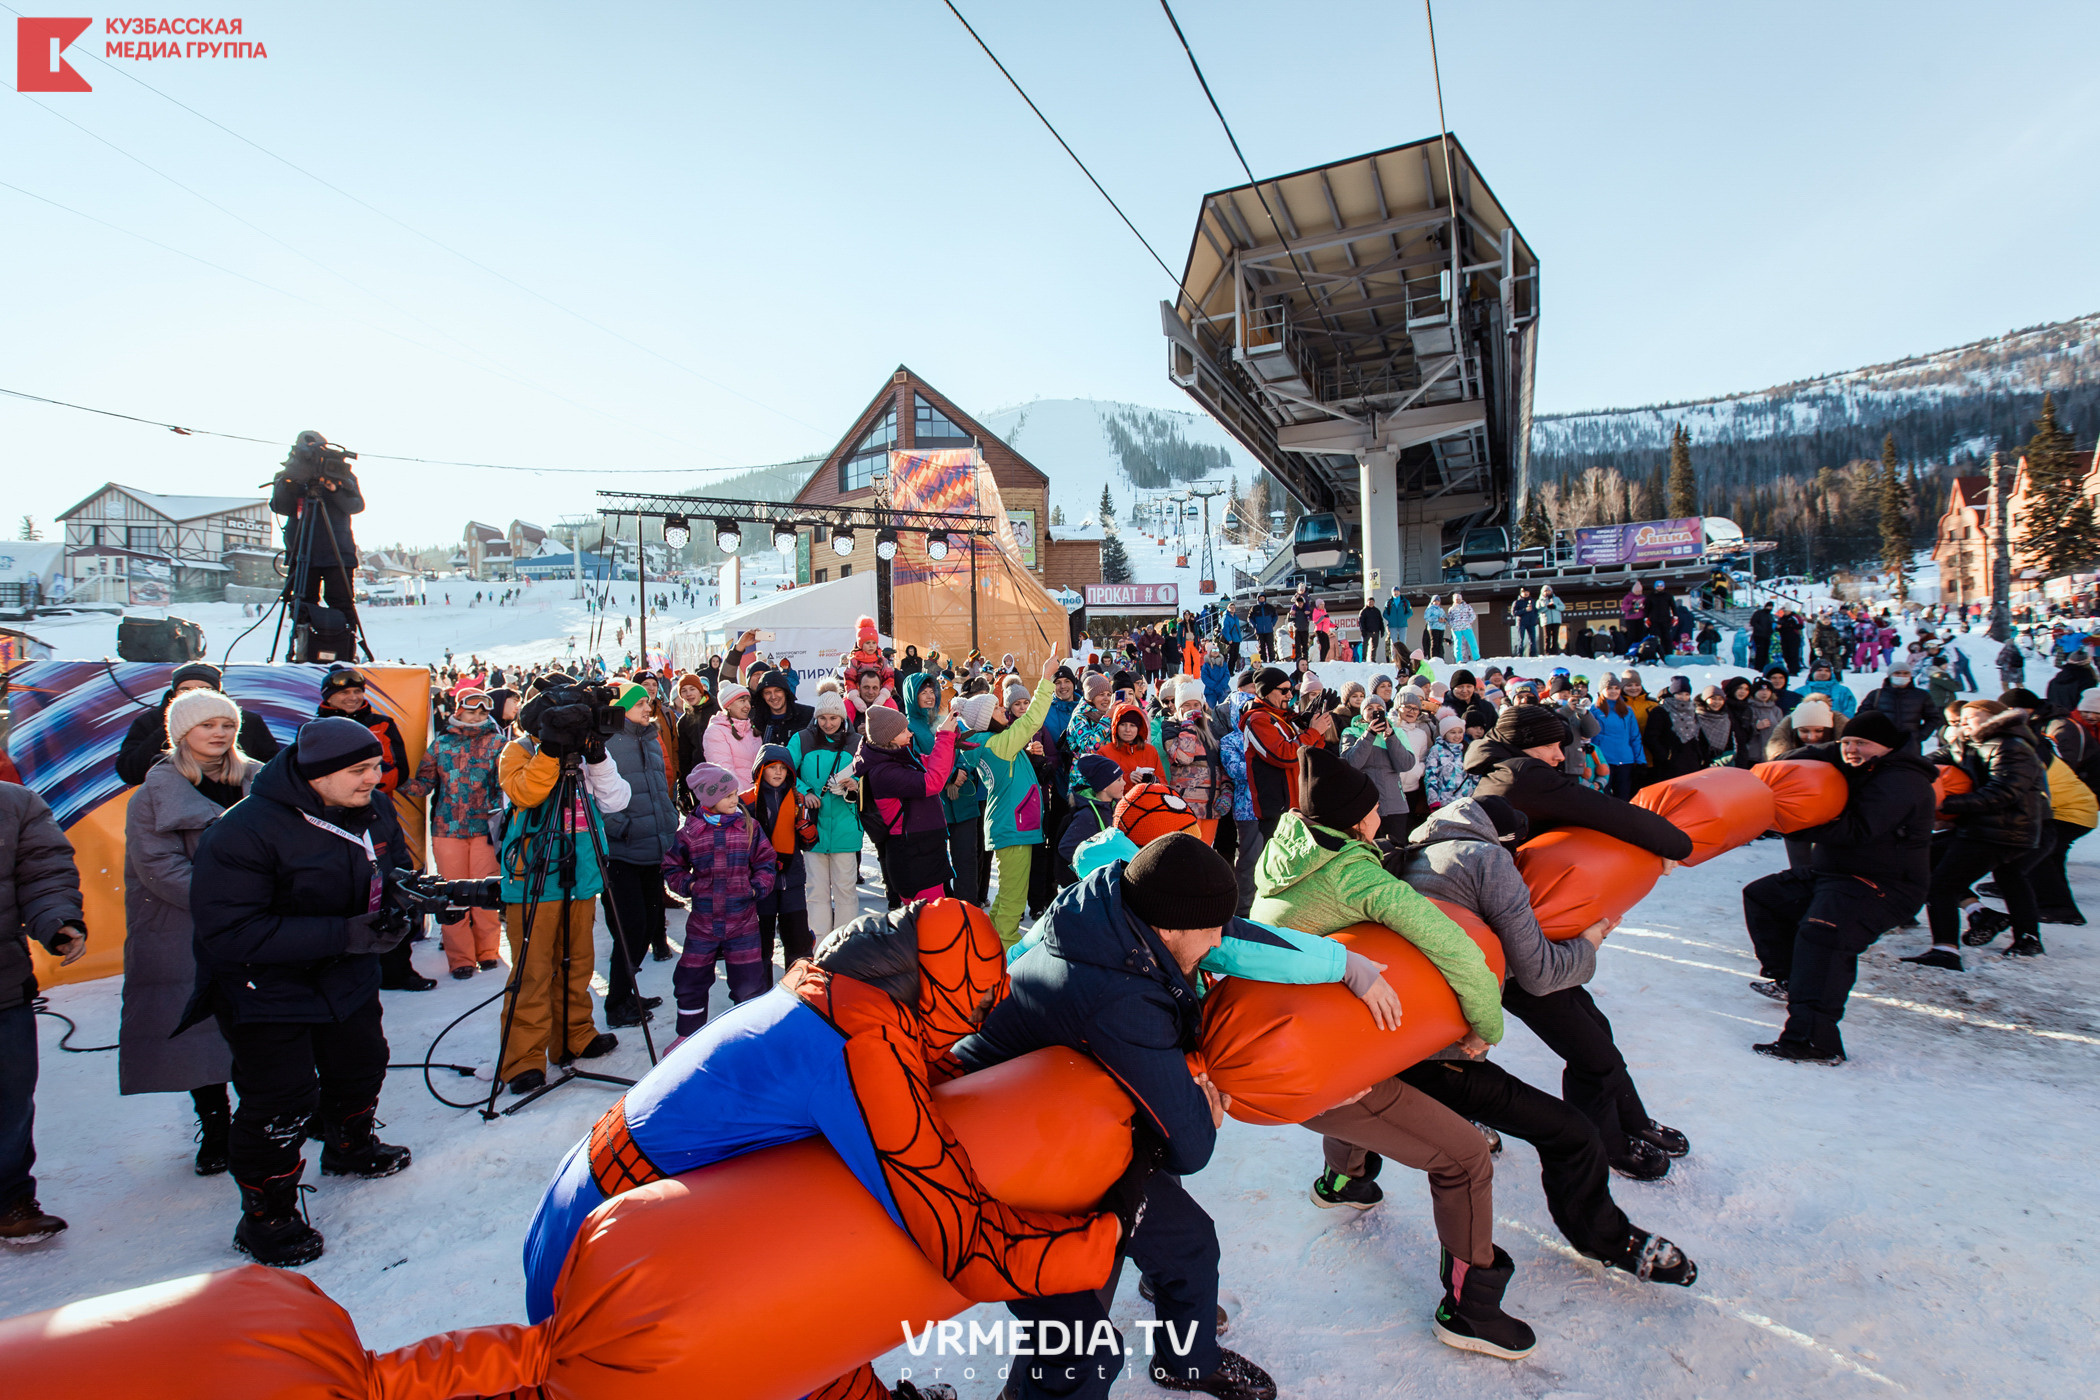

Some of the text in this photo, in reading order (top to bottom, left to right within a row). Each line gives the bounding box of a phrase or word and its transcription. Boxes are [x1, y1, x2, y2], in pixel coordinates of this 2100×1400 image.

[228, 520, 271, 532] ROOKS
[1648, 533, 1693, 544] BELKA
[1637, 549, 1672, 557] БЕСПЛАТНО
[1087, 587, 1138, 603] ПРОКАТ
[1144, 587, 1153, 602] #
[798, 667, 833, 680] ПИРУ
